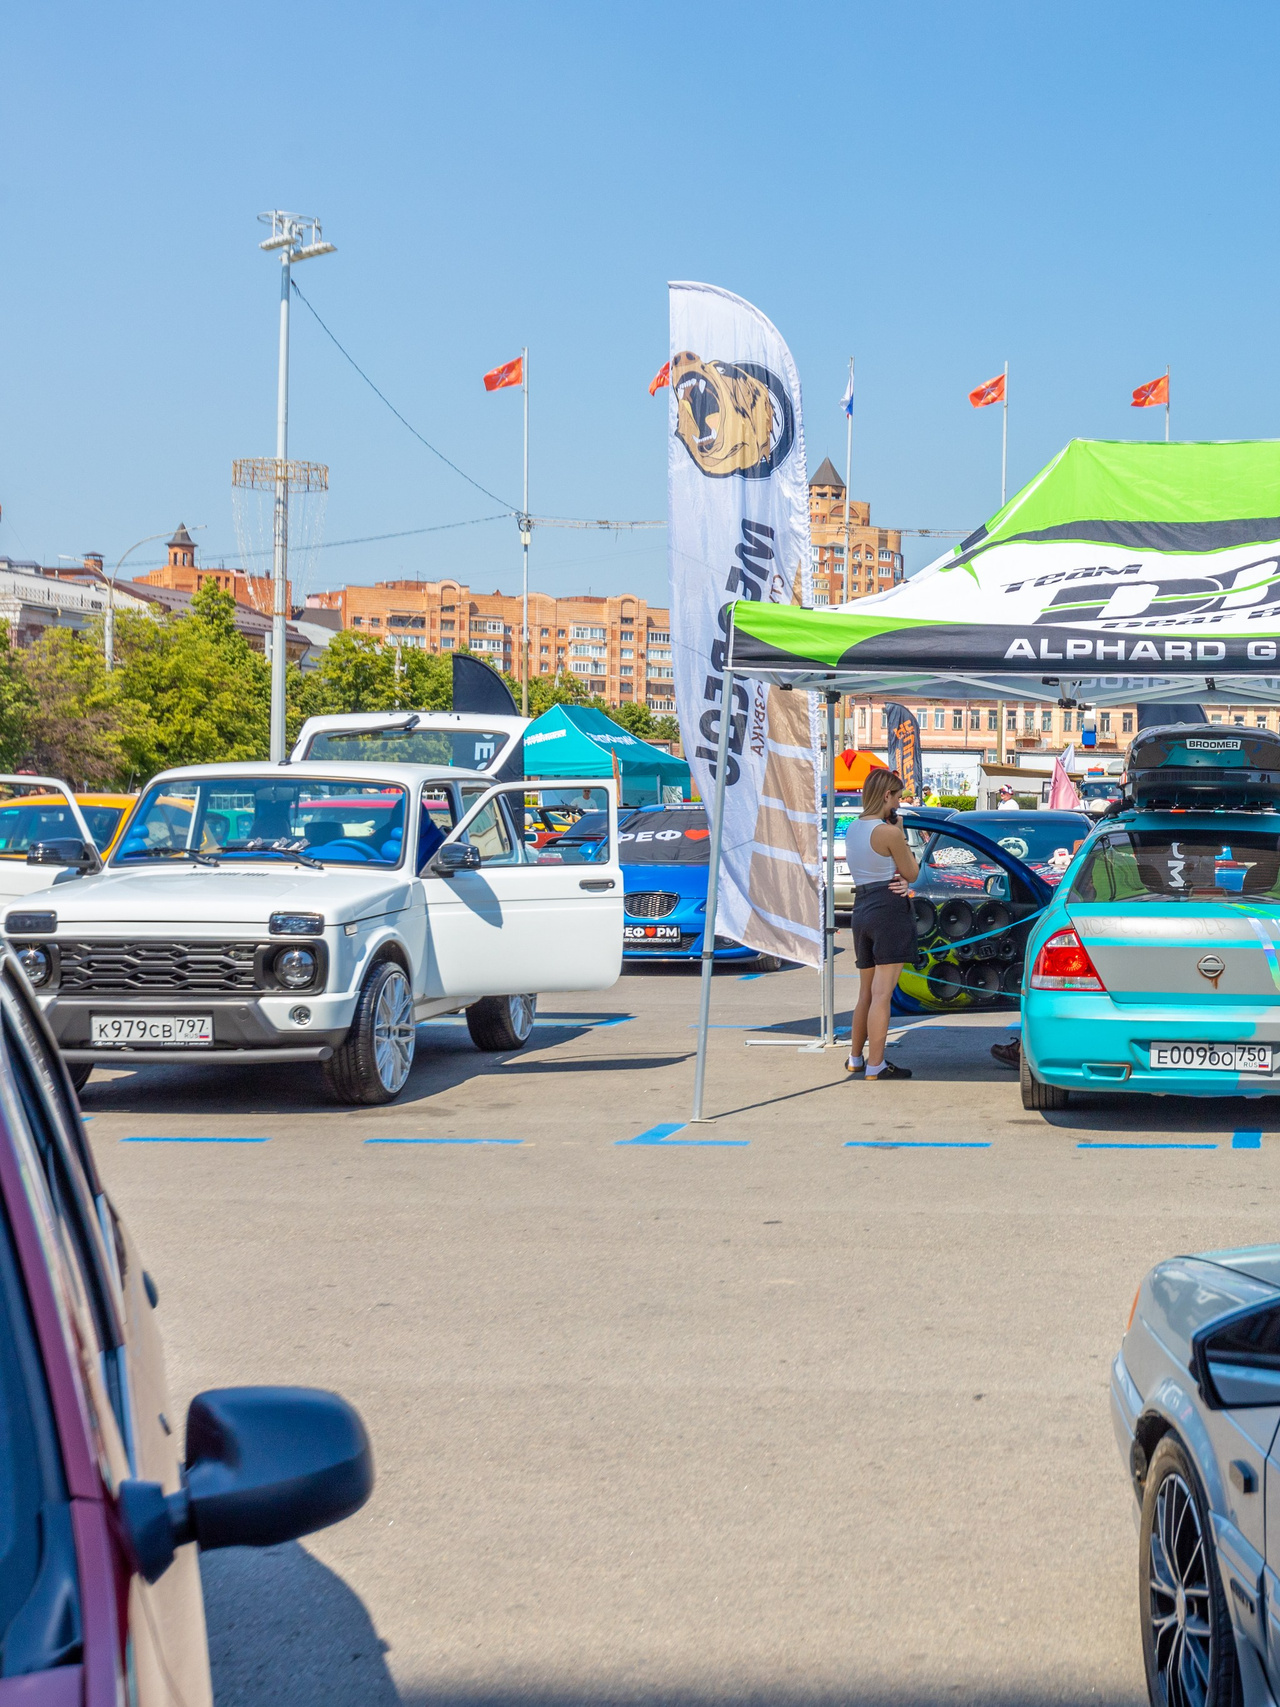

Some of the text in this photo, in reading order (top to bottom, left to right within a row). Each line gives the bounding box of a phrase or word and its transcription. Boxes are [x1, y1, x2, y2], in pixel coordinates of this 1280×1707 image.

[1003, 638, 1226, 661] ALPHARD
[1189, 740, 1239, 749] BROOMER
[177, 1019, 206, 1033] 797
[1237, 1047, 1267, 1062] 750
